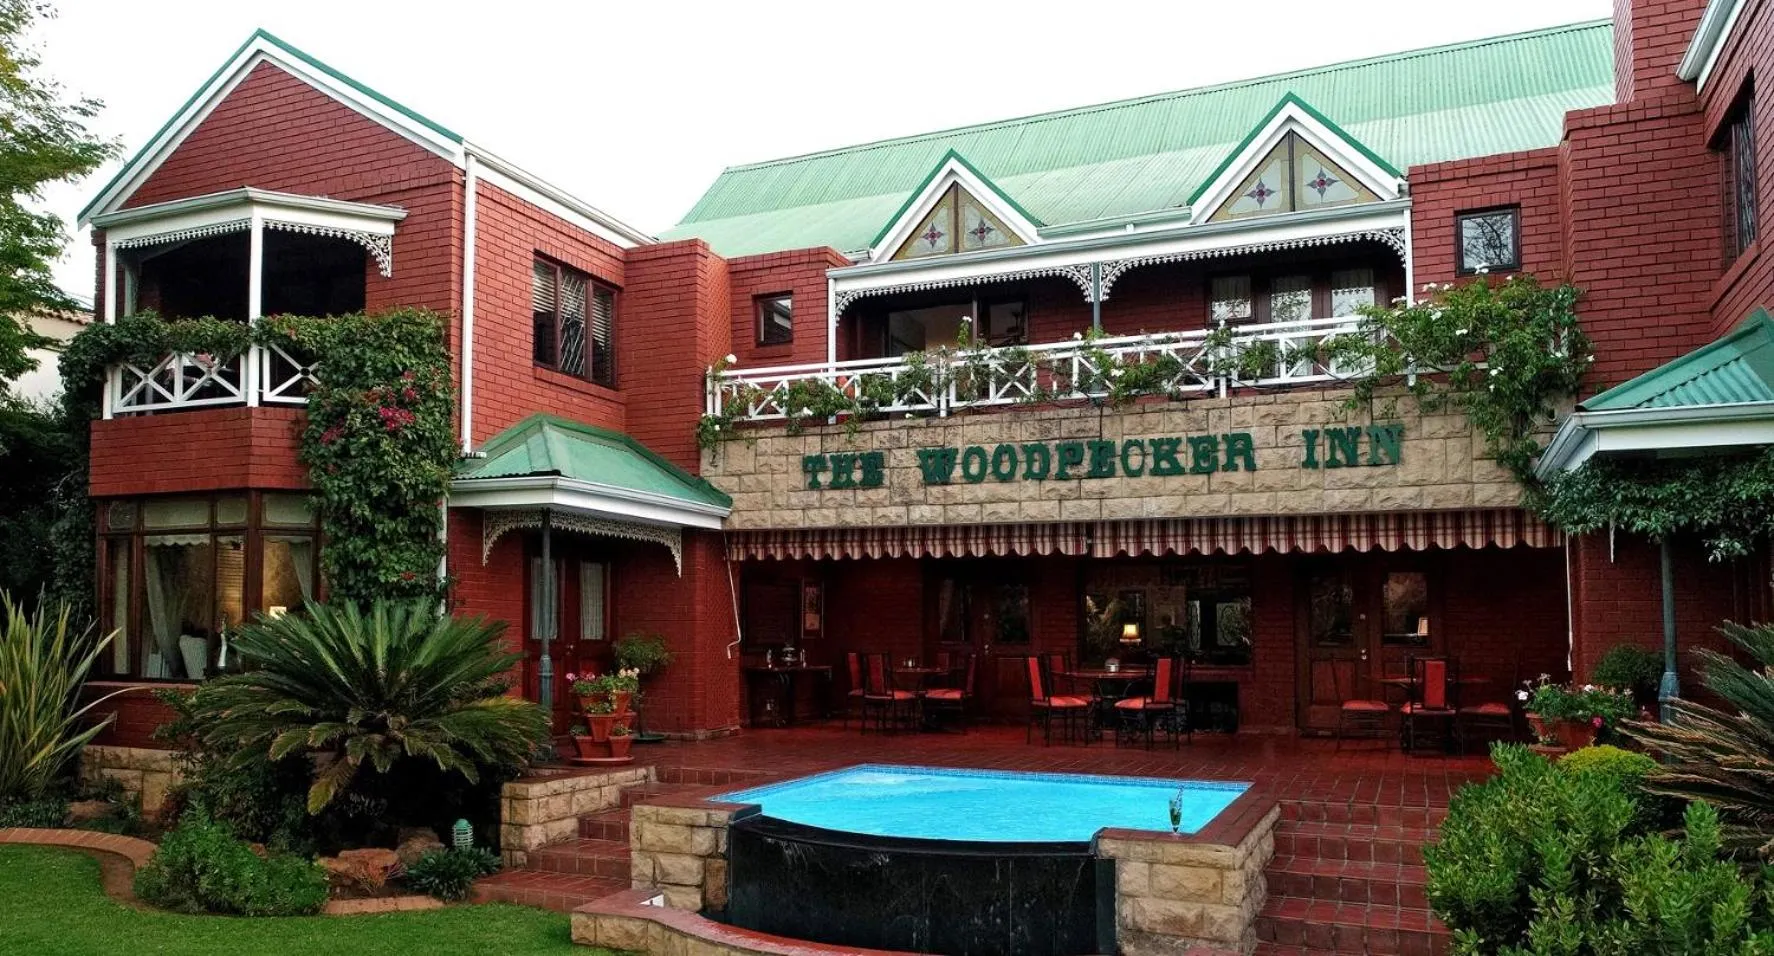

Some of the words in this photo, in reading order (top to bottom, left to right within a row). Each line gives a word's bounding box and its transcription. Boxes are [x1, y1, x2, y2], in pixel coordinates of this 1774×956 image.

[802, 452, 883, 489] THE
[917, 433, 1256, 485] WOODPECKER
[1302, 425, 1404, 469] INN
